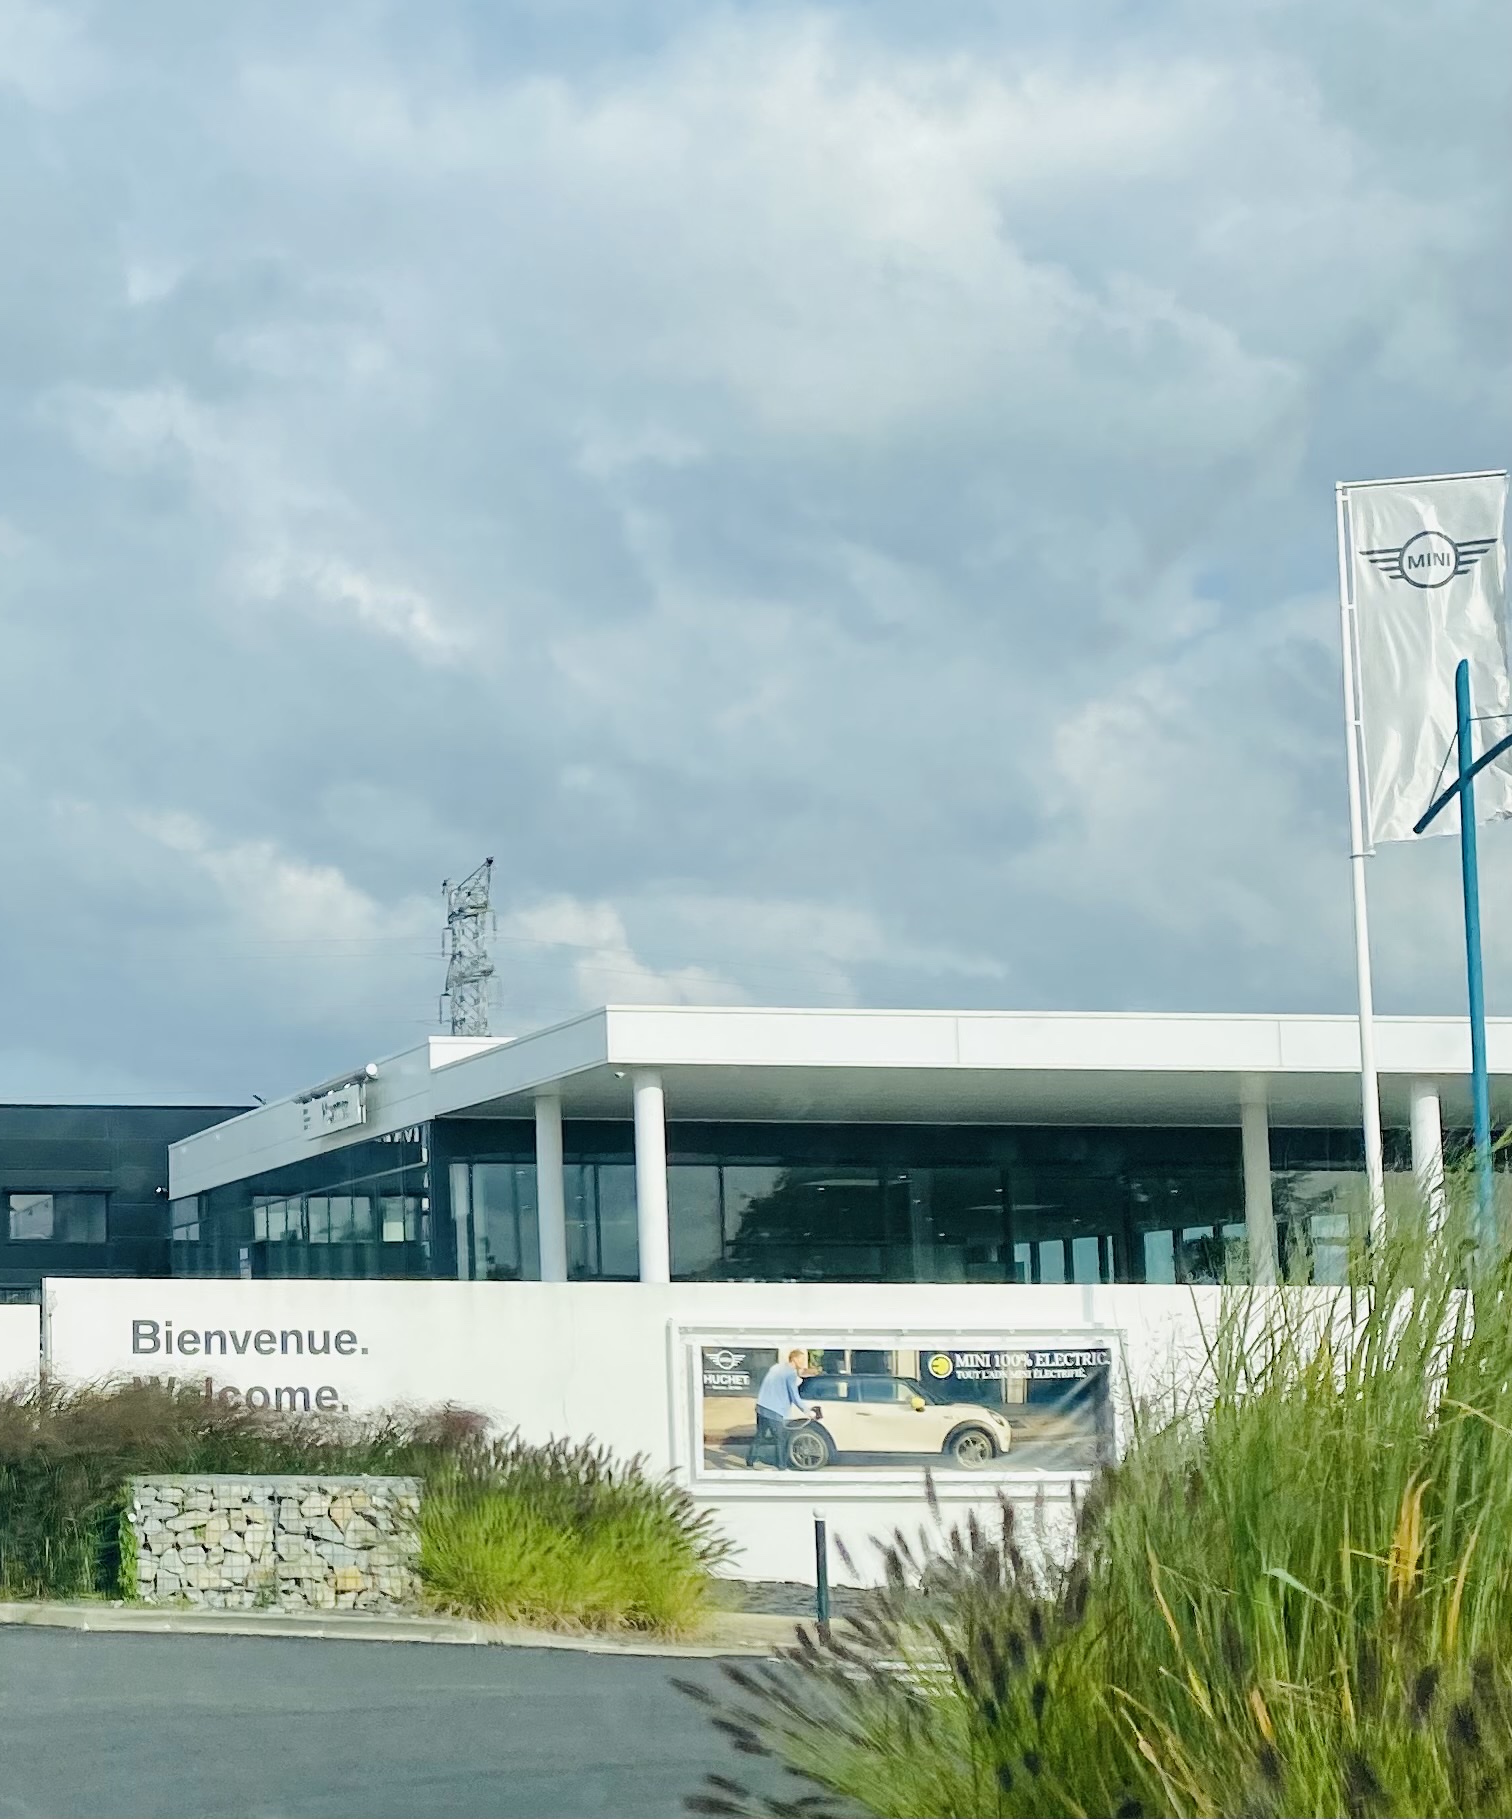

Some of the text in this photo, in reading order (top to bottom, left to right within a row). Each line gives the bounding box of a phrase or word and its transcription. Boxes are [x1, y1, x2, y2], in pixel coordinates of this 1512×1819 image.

[1408, 552, 1451, 569] MINI
[132, 1319, 369, 1355] Bienvenue.
[954, 1353, 991, 1368] MINI
[994, 1353, 1033, 1368] 100%
[703, 1374, 750, 1385] HUCHET
[956, 1370, 982, 1379] TOUT
